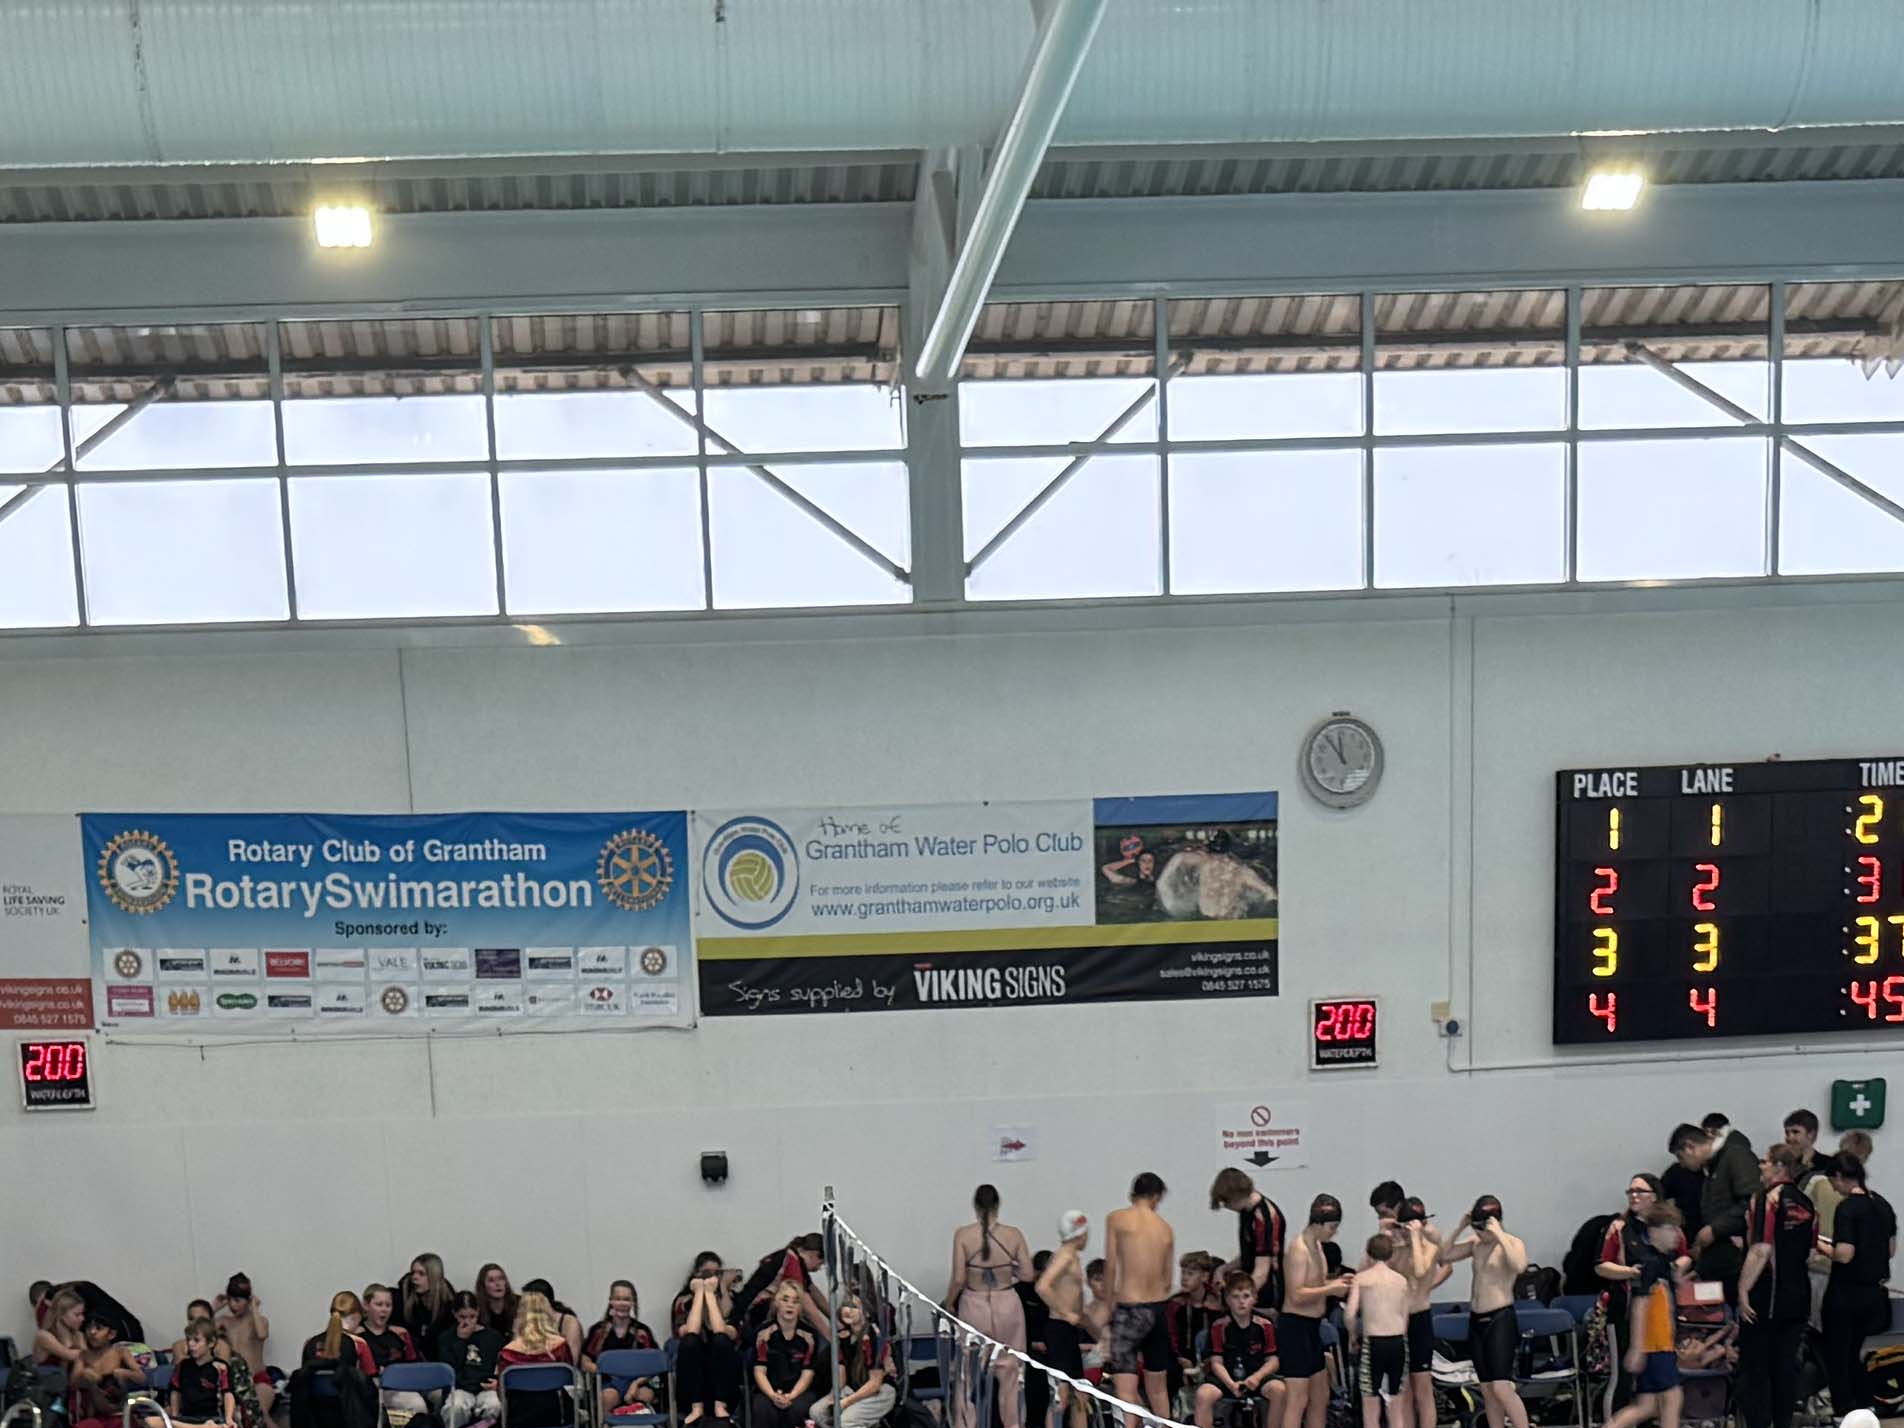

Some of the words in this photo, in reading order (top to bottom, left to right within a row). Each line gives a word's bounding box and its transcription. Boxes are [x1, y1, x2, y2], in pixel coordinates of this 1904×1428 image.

[1574, 771, 1638, 798] PLACE
[1681, 768, 1733, 794] LANE
[1608, 807, 1619, 850] 1
[1711, 804, 1721, 847] 1
[228, 839, 313, 868] Rotary
[322, 838, 381, 863] Club
[389, 838, 415, 863] of
[423, 839, 546, 862] Grantham
[805, 840, 909, 860] Grantham
[914, 836, 977, 857] Water
[983, 834, 1029, 854] Polo
[1035, 832, 1083, 852] Club
[185, 871, 593, 918] RotarySwimarathon
[810, 884, 829, 896] For
[832, 886, 862, 896] more
[864, 882, 928, 895] information
[810, 892, 1080, 919] www.granthamwaterpolo.org.uk
[1590, 867, 1619, 914] 2
[1692, 864, 1719, 911] 2
[334, 920, 419, 938] Sponsored
[423, 920, 448, 938] by:
[1592, 927, 1618, 977] 3
[1693, 922, 1719, 972] 3
[728, 979, 781, 1009] Signs
[790, 977, 864, 1008] supplied
[872, 979, 896, 1005] by
[913, 966, 1001, 1002] VIKING
[1005, 966, 1066, 998] SIGNS
[1316, 1004, 1375, 1041] 200
[1589, 992, 1616, 1032] 4
[1689, 988, 1717, 1027] 4
[25, 1043, 84, 1081] 200
